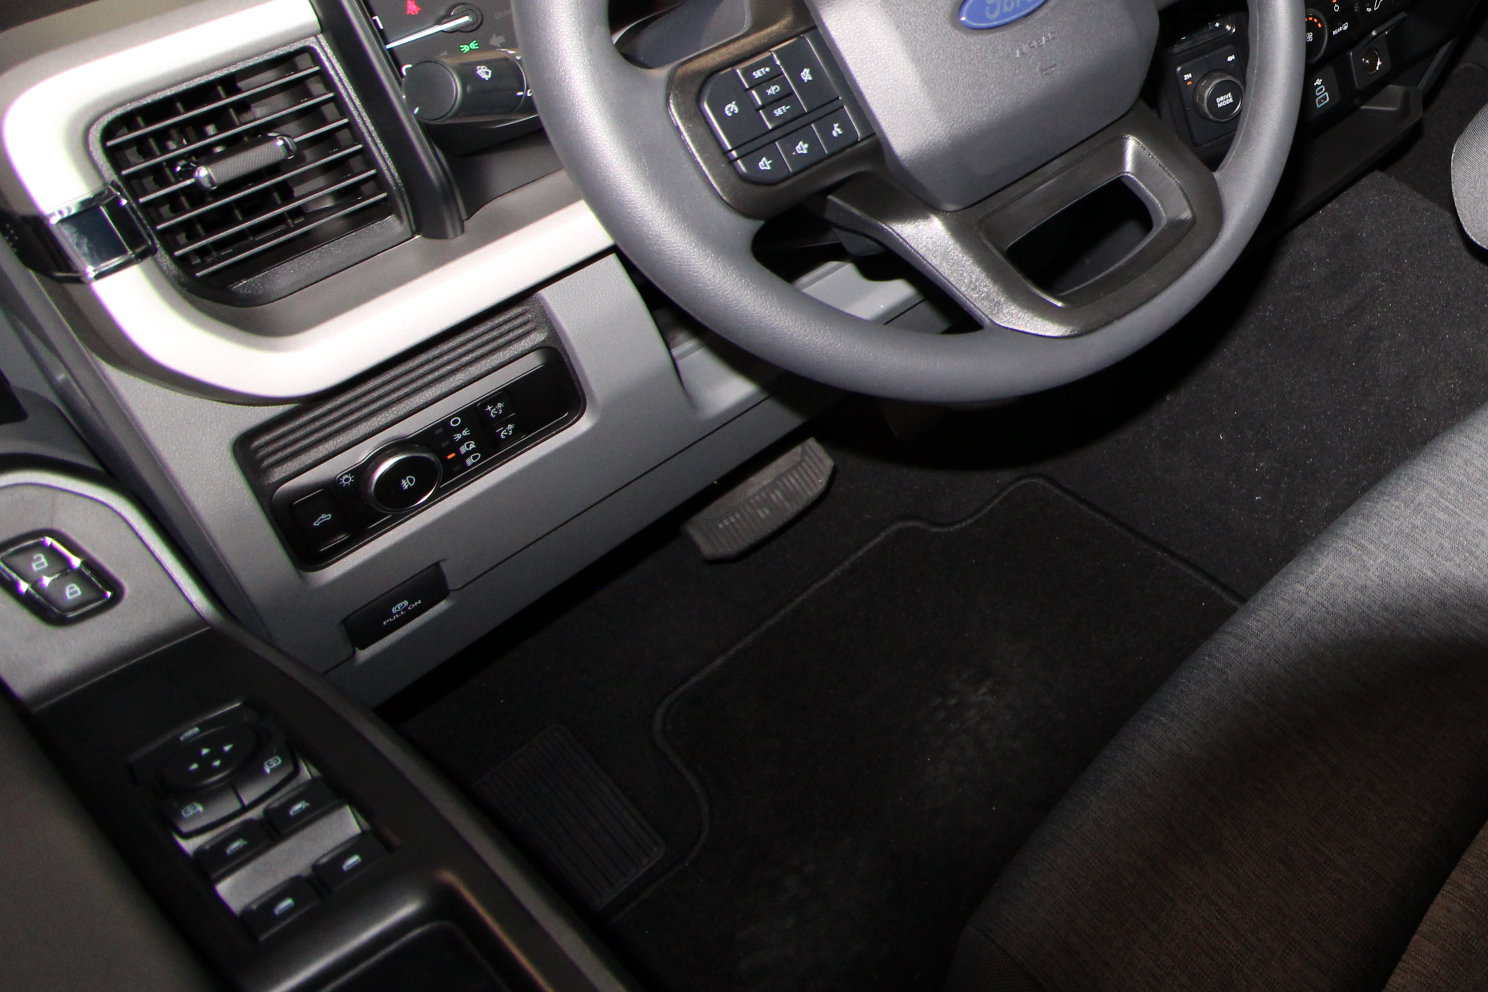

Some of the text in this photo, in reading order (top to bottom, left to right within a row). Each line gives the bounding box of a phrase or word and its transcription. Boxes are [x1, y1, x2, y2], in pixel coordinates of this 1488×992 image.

[372, 15, 384, 30] 1
[1183, 72, 1192, 81] 2H
[1215, 92, 1233, 103] DRIVE
[1217, 97, 1234, 109] MODE
[383, 599, 421, 625] PULL ON
